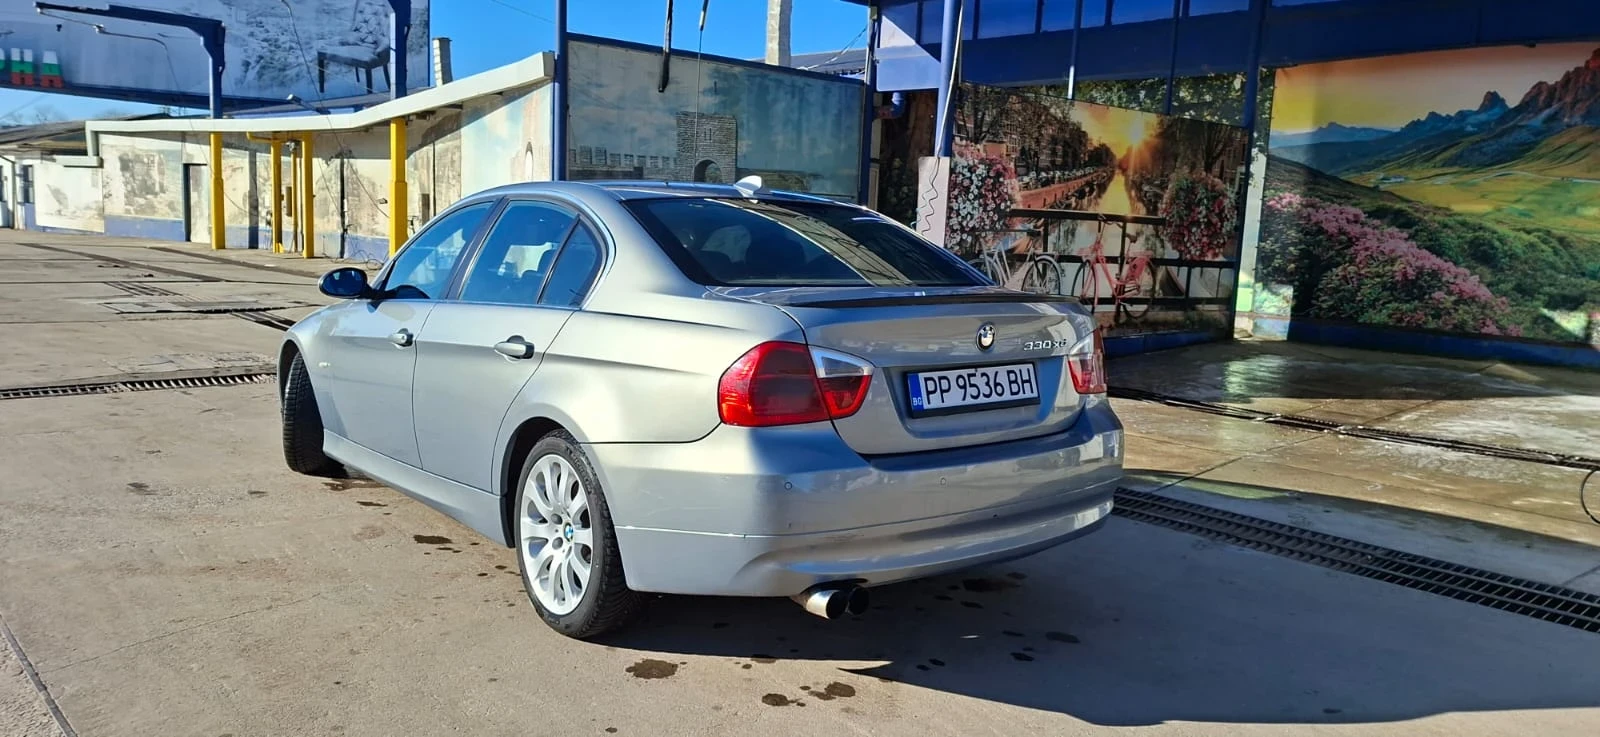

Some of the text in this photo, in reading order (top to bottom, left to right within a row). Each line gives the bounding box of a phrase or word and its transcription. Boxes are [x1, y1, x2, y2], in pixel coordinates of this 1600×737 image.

[0, 48, 64, 88] НА
[1023, 339, 1067, 351] 330xi
[924, 367, 1034, 405] PP 9536 BH
[912, 396, 923, 406] BG
